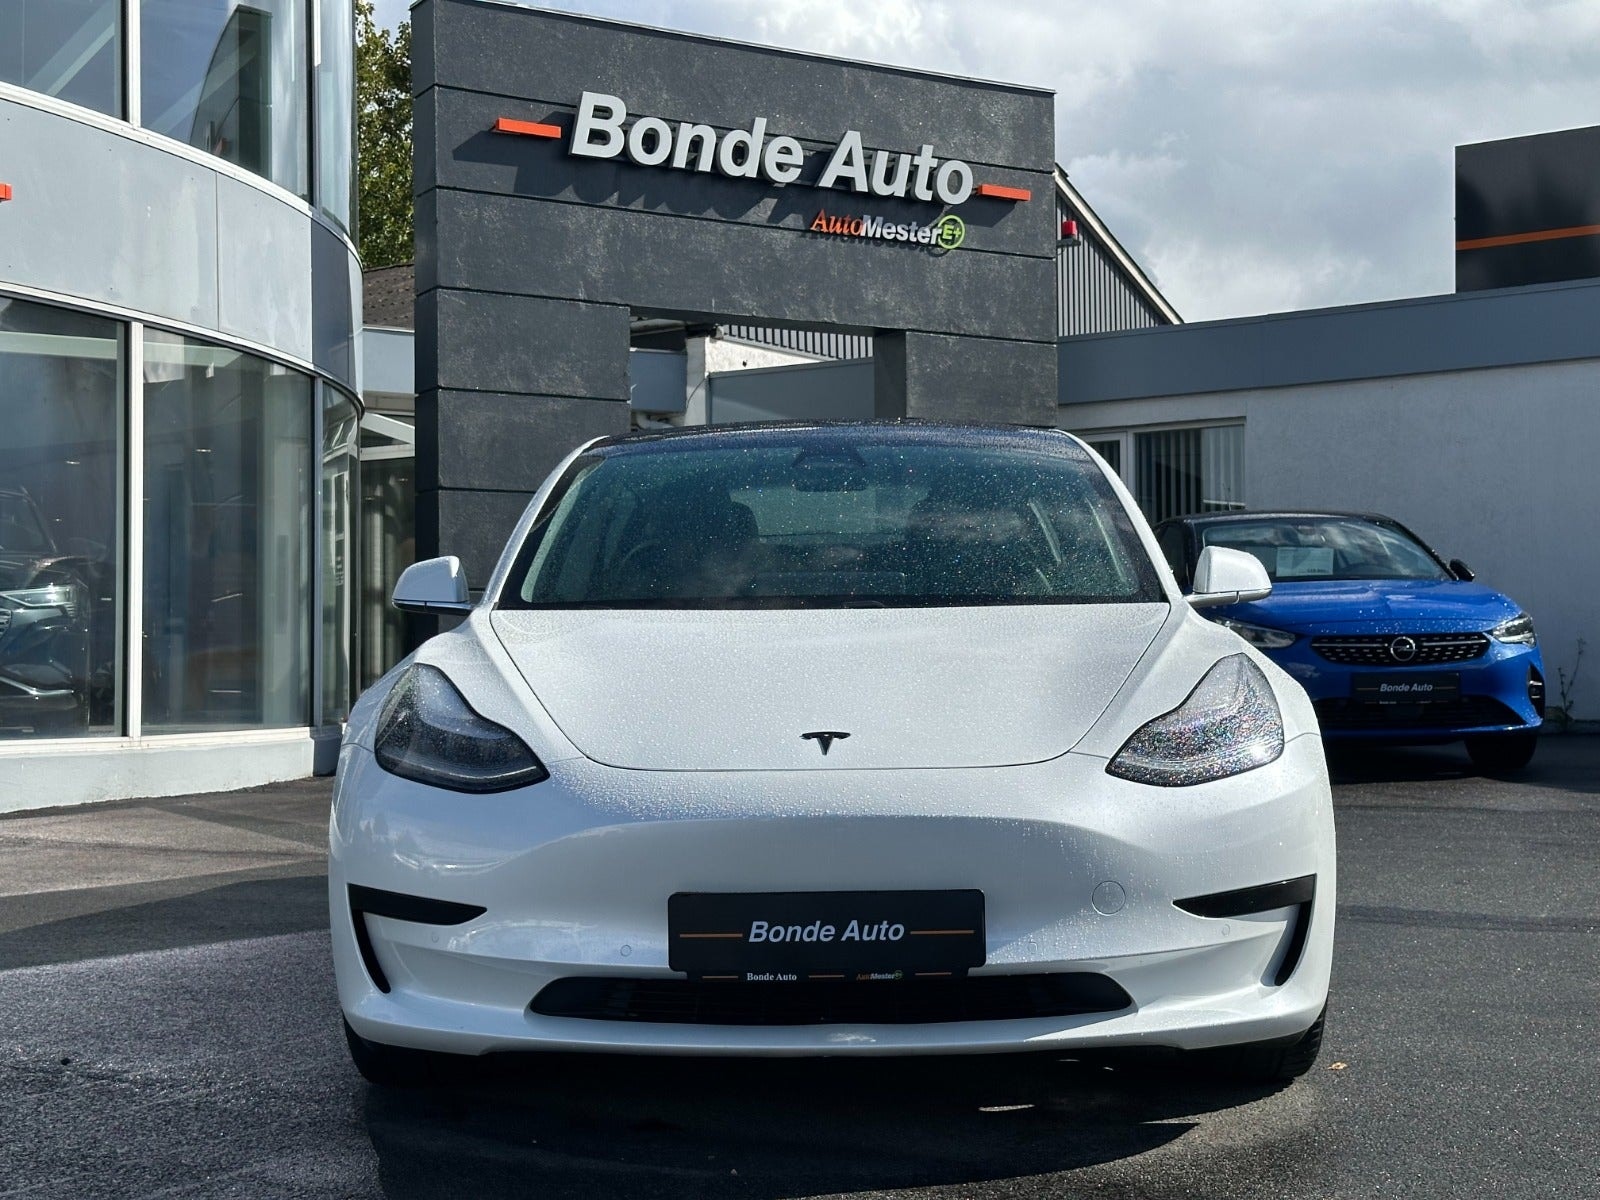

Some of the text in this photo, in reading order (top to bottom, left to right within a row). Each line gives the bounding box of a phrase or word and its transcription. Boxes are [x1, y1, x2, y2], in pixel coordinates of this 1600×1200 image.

[570, 91, 974, 205] Bonde Auto
[810, 208, 942, 245] AutoMester
[1380, 683, 1433, 692] Bonde Auto
[748, 919, 905, 943] Bonde Auto
[747, 972, 797, 981] Bonde Auto
